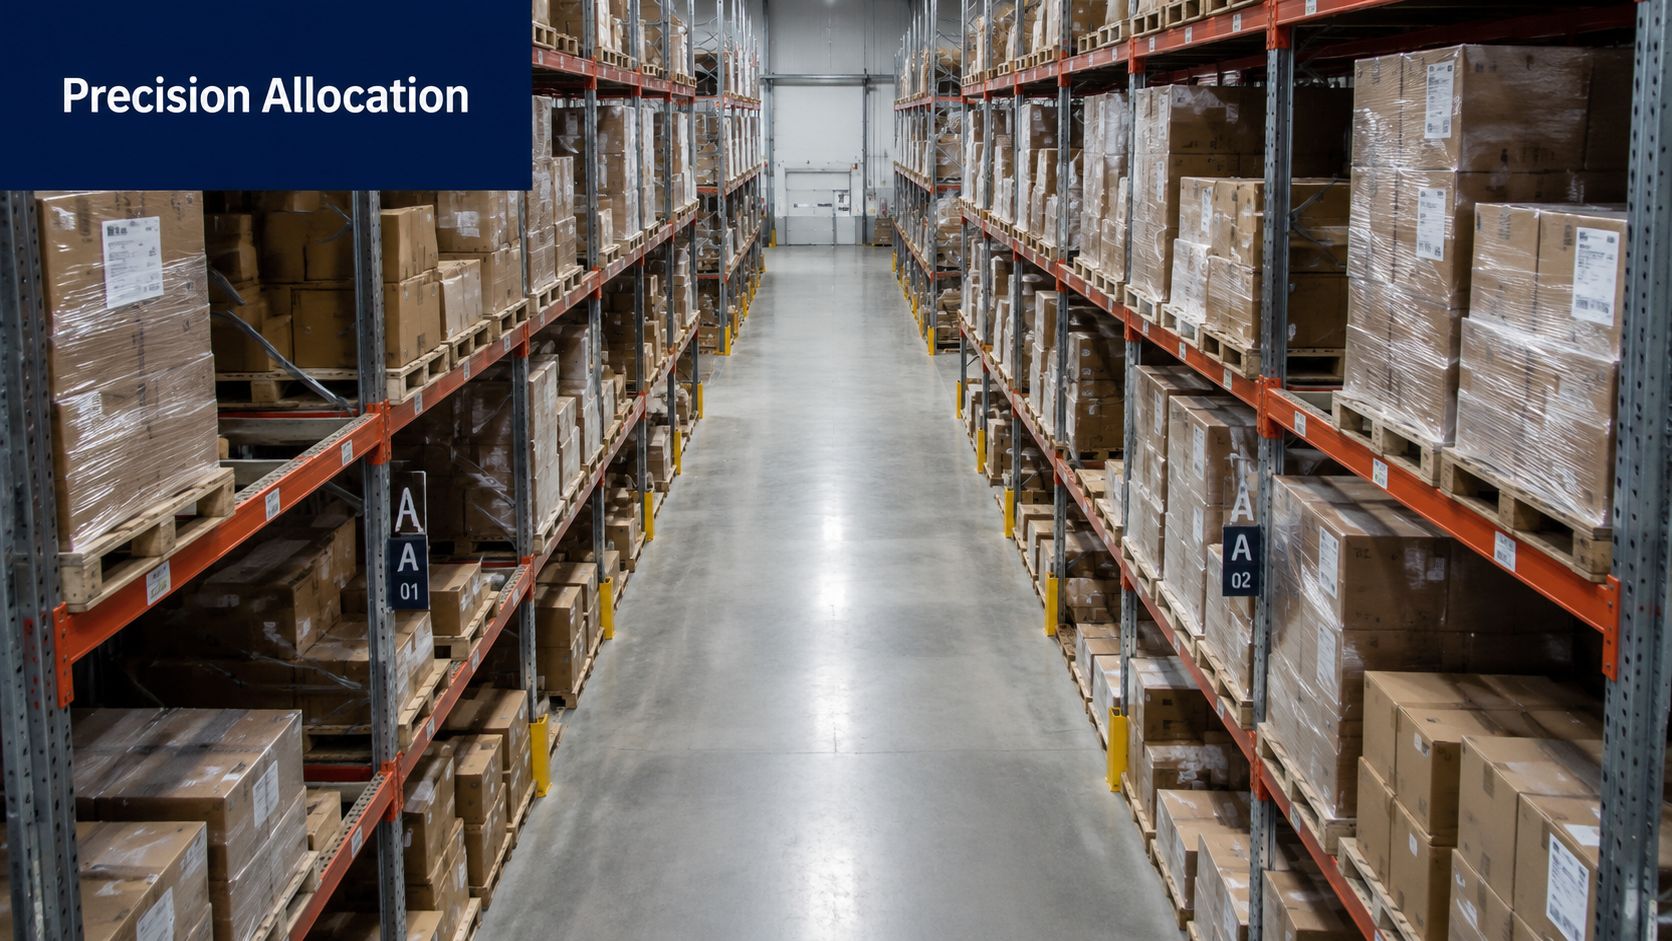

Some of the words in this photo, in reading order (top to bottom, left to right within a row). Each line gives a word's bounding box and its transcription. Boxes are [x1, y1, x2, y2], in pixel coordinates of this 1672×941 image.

[395, 487, 424, 533] A
[1230, 481, 1254, 522] A
[397, 542, 419, 572] A
[1231, 534, 1252, 561] A
[400, 583, 418, 600] 01
[1231, 572, 1251, 589] 02
